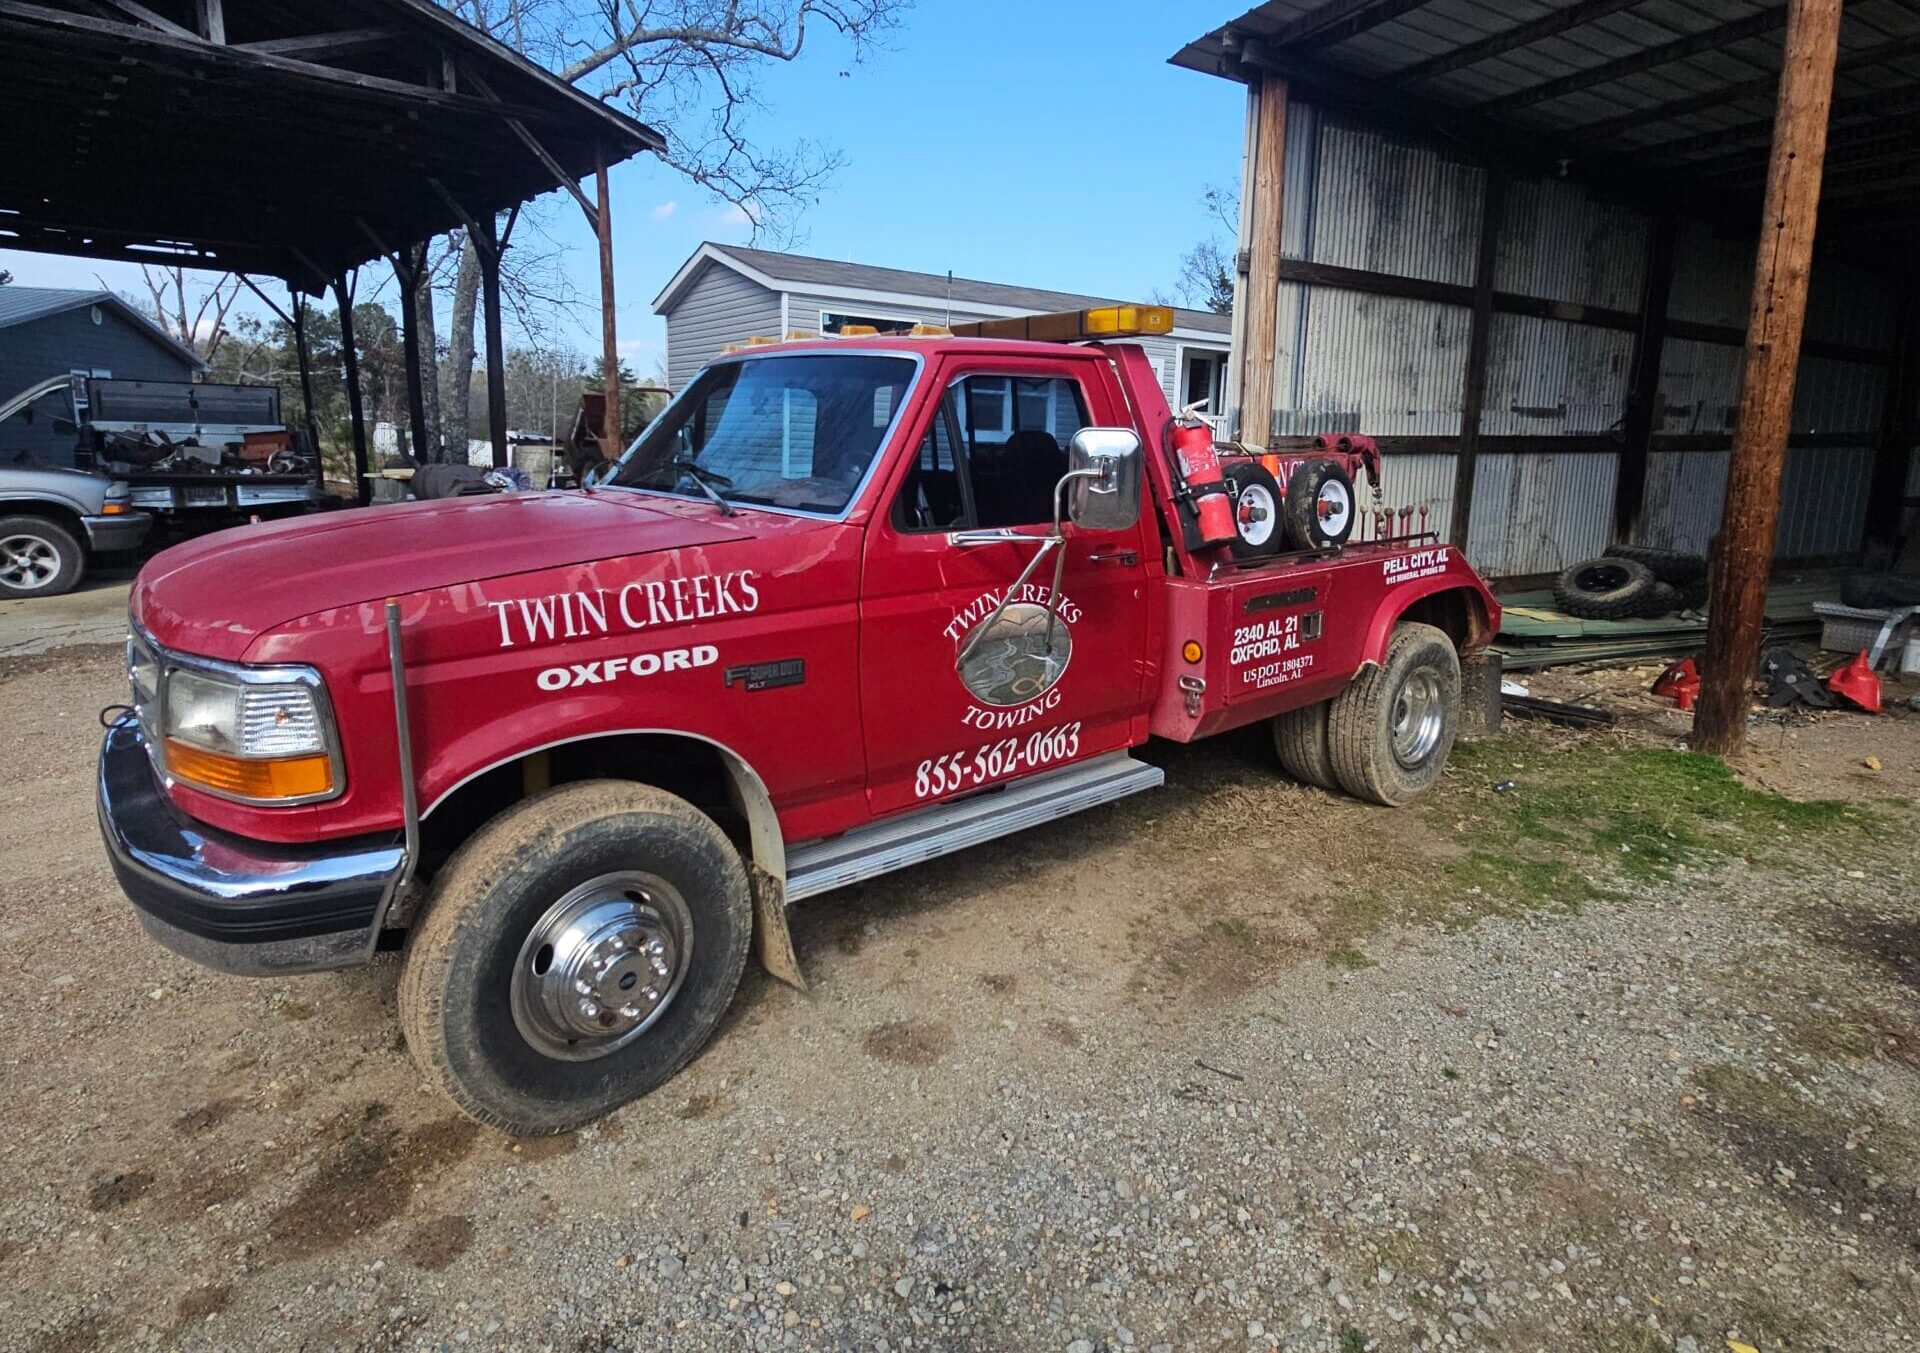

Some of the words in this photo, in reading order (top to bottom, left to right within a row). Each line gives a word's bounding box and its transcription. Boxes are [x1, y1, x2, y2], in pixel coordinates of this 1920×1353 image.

[1383, 557, 1409, 575] PELL
[1411, 550, 1435, 568] CITY,
[1436, 548, 1449, 563] AL
[488, 589, 608, 648] TWIN
[619, 569, 759, 630] CREEKS
[943, 588, 1001, 641] TWIN
[1230, 638, 1281, 665] OXFORD,
[1283, 633, 1300, 651] AL
[1234, 623, 1265, 647] 2340
[1266, 619, 1283, 638] AL
[1285, 615, 1298, 633] 21
[536, 645, 719, 691] OXFORD
[1243, 669, 1257, 683] US
[1257, 662, 1281, 679] DOT
[1282, 655, 1313, 672] 1804371
[1291, 669, 1303, 680] AL
[961, 688, 1062, 730] TOWING
[914, 721, 1081, 798] 855-562-0663
